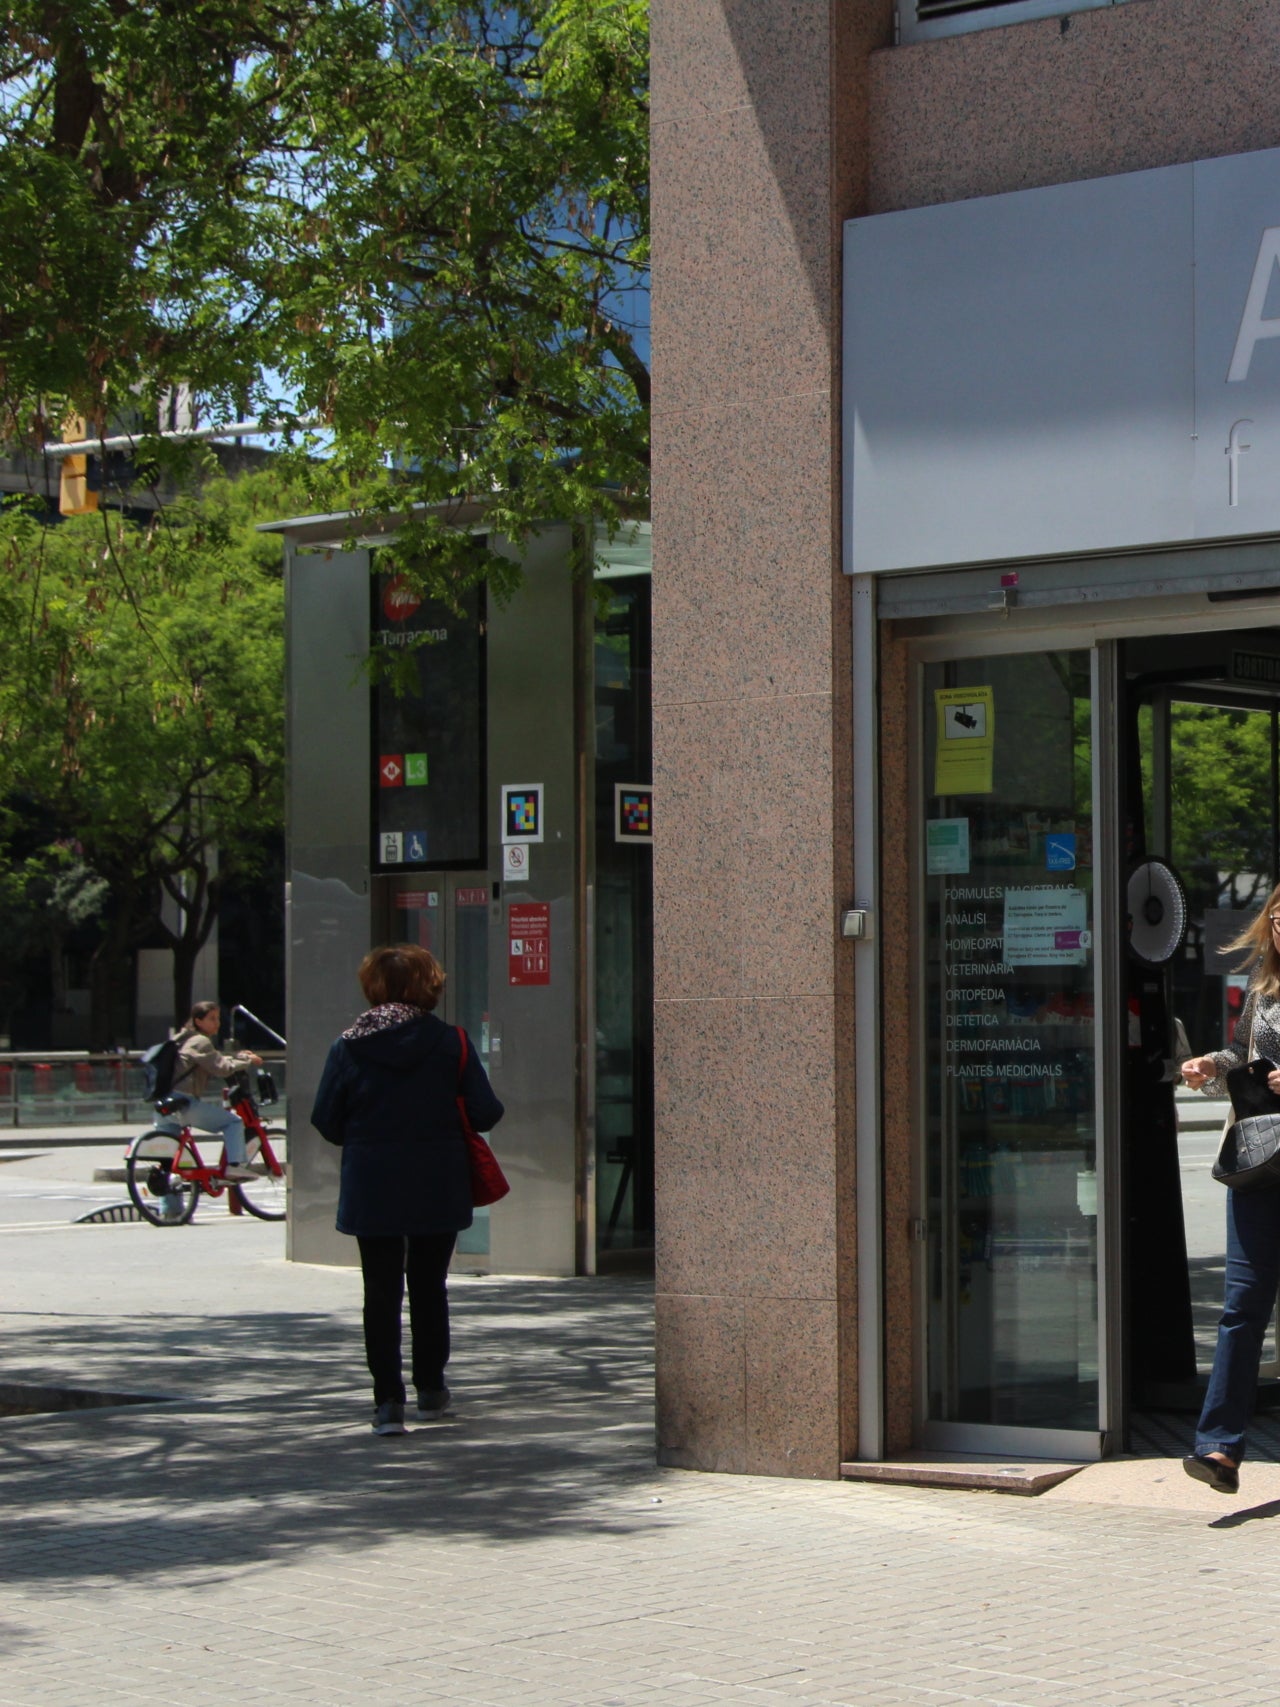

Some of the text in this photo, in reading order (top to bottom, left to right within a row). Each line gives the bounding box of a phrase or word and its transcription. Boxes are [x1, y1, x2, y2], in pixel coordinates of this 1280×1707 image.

[405, 759, 427, 779] L3
[944, 910, 987, 926] ANÀLISI
[945, 937, 1005, 952] HOMEOPAT
[945, 960, 1015, 976] VETERINÀRIA
[945, 986, 1006, 1001] ORTOPÈDIA
[946, 1036, 1041, 1051] DERMOFARMÀCIA
[946, 1063, 1063, 1077] PLANTES MEDICINALS
